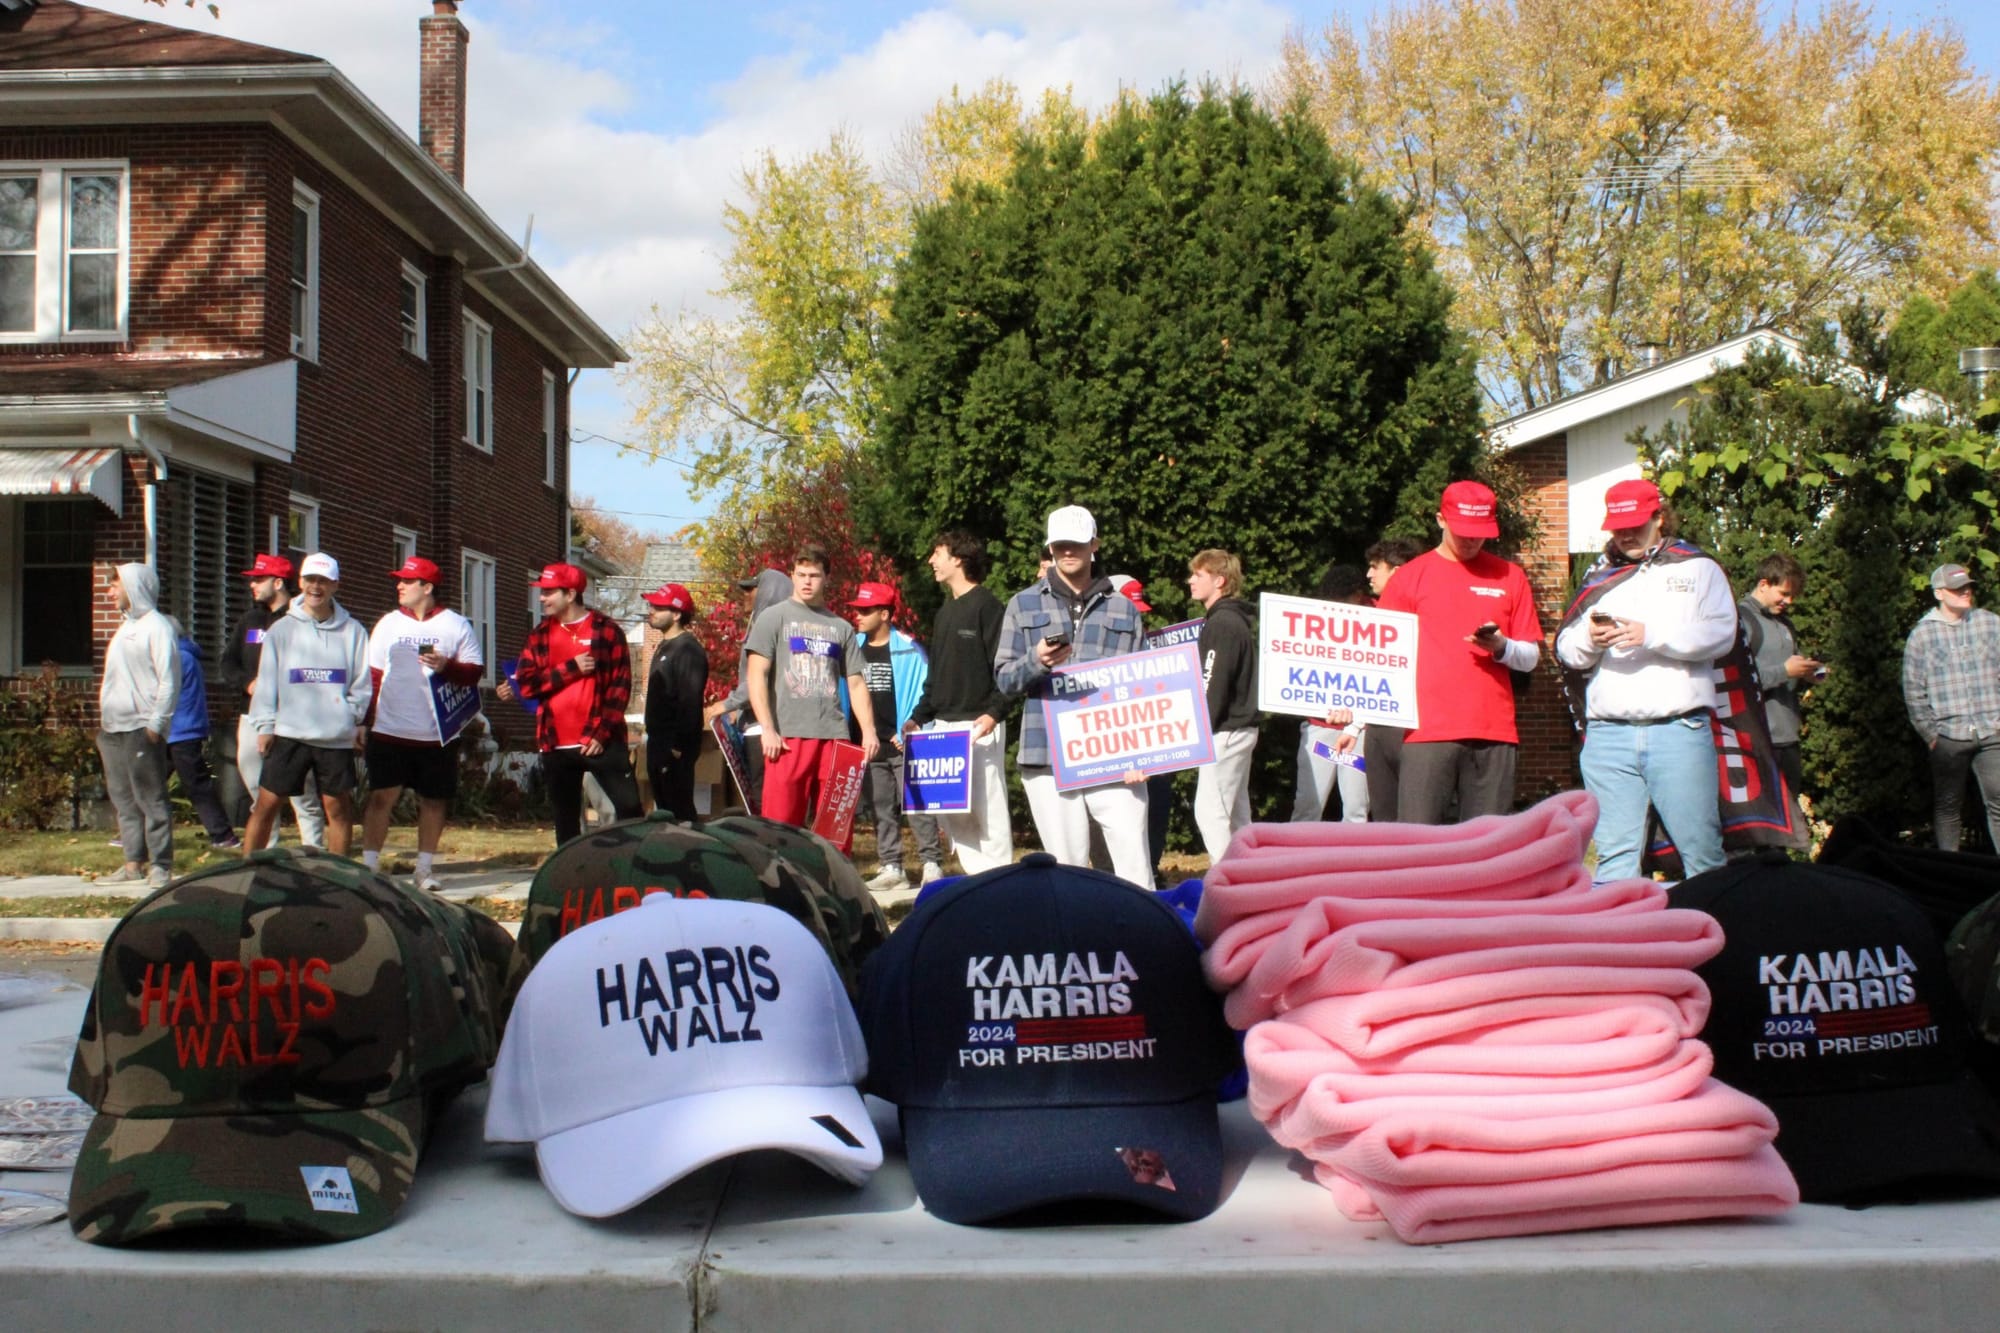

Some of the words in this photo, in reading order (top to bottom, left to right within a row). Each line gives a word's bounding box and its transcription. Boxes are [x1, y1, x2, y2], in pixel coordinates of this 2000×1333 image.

[398, 636, 440, 645] TRUMP
[1282, 611, 1399, 649] TRUMP
[1271, 639, 1336, 659] SECURE
[1342, 649, 1409, 669] BORDER
[1052, 653, 1190, 696] PENNSYLVANIA
[1289, 667, 1392, 697] KAMALA
[1114, 686, 1129, 701] IS
[1280, 687, 1326, 705] OPEN
[1332, 694, 1399, 713] BORDER
[1077, 698, 1173, 734] TRUMP
[1066, 719, 1190, 762] COUNTRY
[908, 757, 965, 778] TRUMP
[827, 771, 846, 812] TEXT
[834, 766, 857, 823] TRUMP
[966, 951, 1139, 988] KAMALA
[1759, 945, 1918, 984] KAMALA
[139, 958, 336, 1028] HARRIS
[596, 945, 780, 1028] HARRIS
[973, 982, 1133, 1020] HARRIS
[1768, 974, 1917, 1015] HARRIS
[174, 1021, 302, 1070] WALZ
[638, 1001, 763, 1057] WALZ
[968, 1026, 1016, 1043] 2024
[1753, 1042, 1807, 1061] FOR
[1818, 1026, 1939, 1056] PRESIDENT
[1765, 1020, 1816, 1036] 2024
[959, 1048, 1006, 1068] FOR
[1017, 1038, 1157, 1064] PRESIDENT
